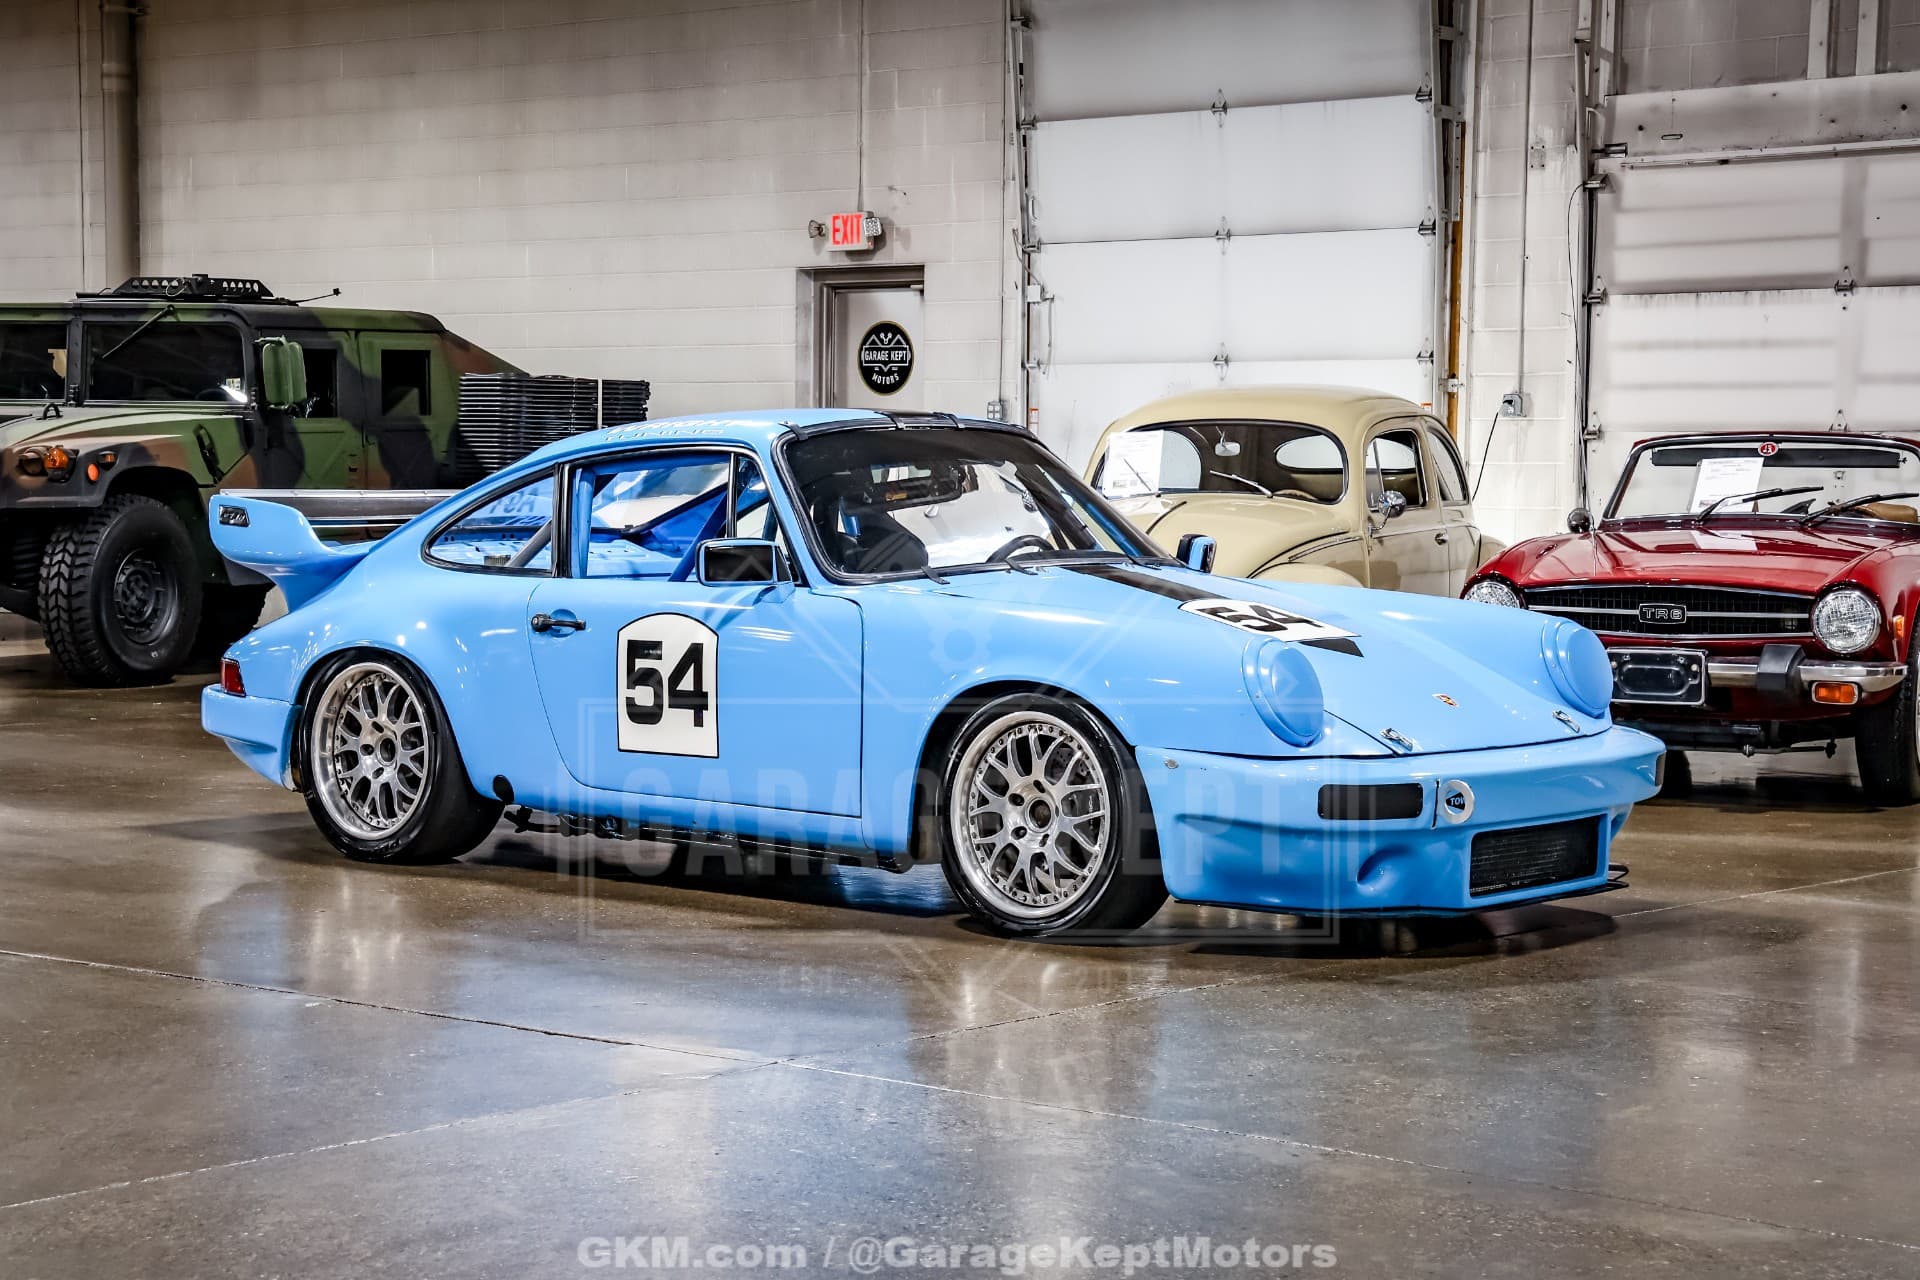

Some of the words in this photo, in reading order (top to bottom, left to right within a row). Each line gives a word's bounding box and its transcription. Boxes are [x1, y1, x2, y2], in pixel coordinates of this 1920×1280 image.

[831, 213, 864, 246] EXIT
[864, 350, 889, 361] GARAGE
[890, 350, 907, 361] KEPT
[871, 372, 900, 385] MOTORS
[1196, 604, 1325, 632] 54
[1642, 607, 1683, 620] TR6
[625, 639, 709, 728] 54
